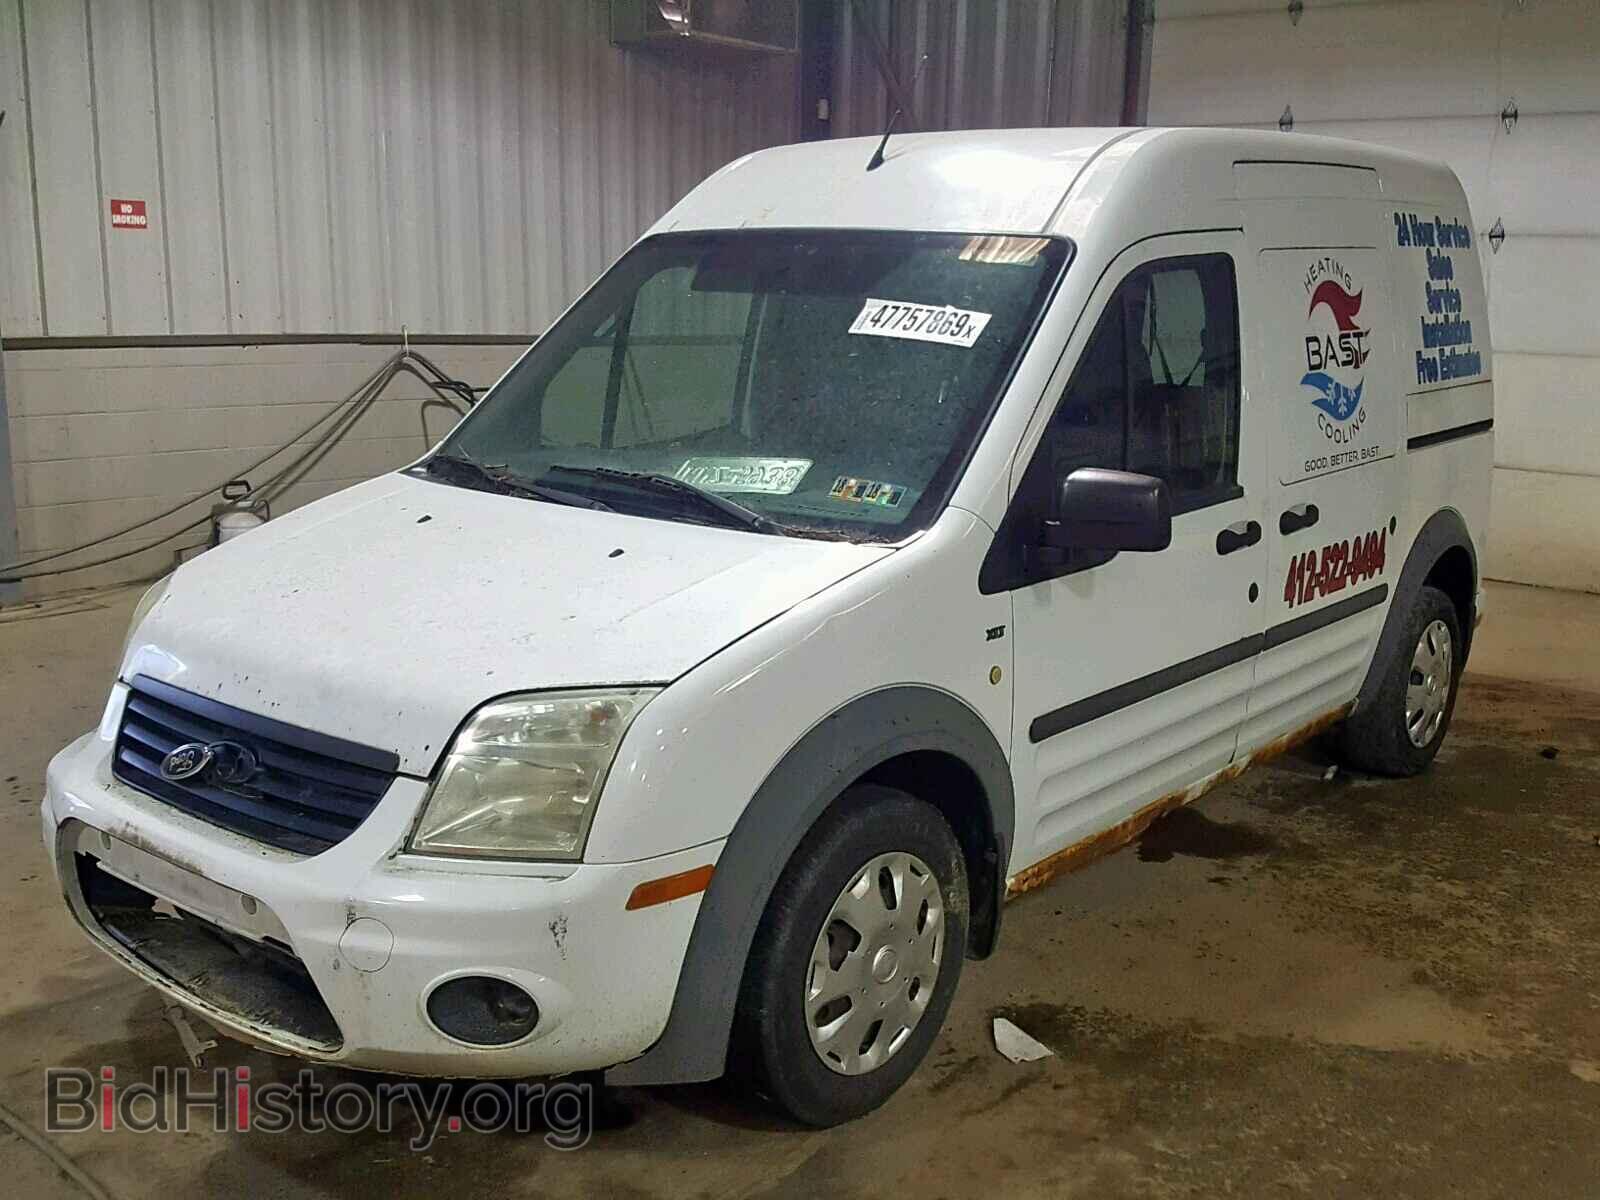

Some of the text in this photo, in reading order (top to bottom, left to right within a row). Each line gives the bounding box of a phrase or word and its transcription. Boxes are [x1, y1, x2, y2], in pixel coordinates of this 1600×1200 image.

[112, 214, 146, 225] SMOKING
[1394, 212, 1471, 249] 24 Hour Service
[1303, 257, 1352, 294] HEATING
[1426, 247, 1454, 281] Sales
[1425, 281, 1462, 315] Service
[1305, 328, 1371, 371] BAST
[1416, 350, 1439, 384] Free
[1317, 407, 1367, 444] COOLING
